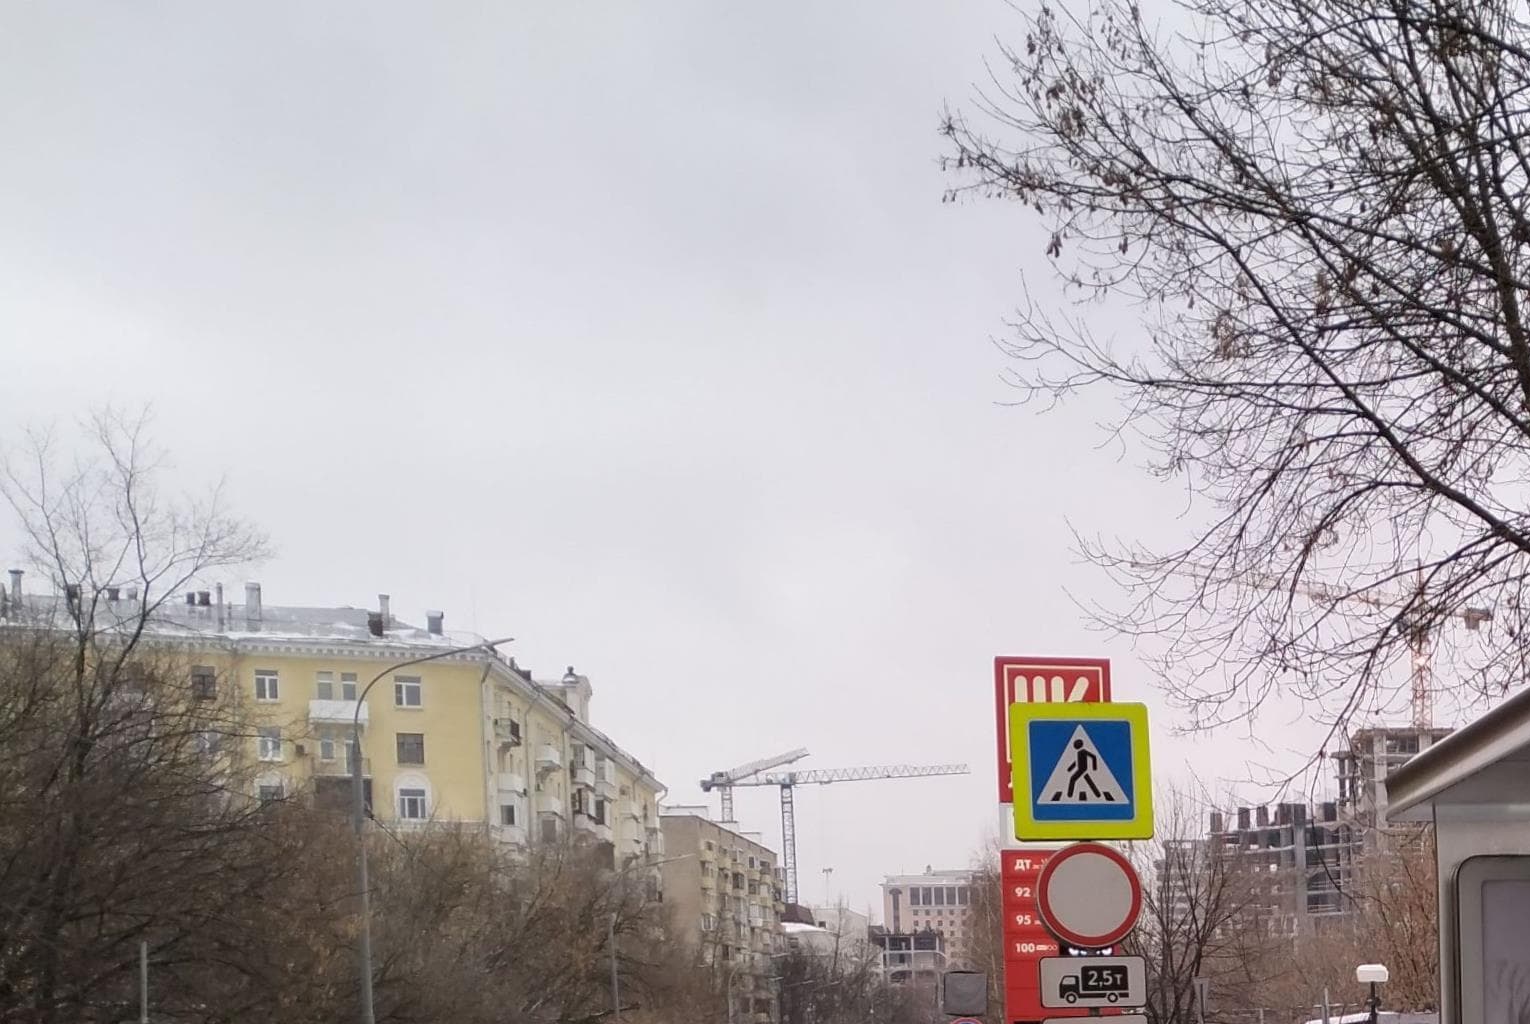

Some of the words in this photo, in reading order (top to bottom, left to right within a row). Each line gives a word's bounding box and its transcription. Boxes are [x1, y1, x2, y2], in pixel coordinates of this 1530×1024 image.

[1014, 887, 1031, 897] 92
[1016, 915, 1032, 925] 95
[1015, 943, 1035, 953] 100
